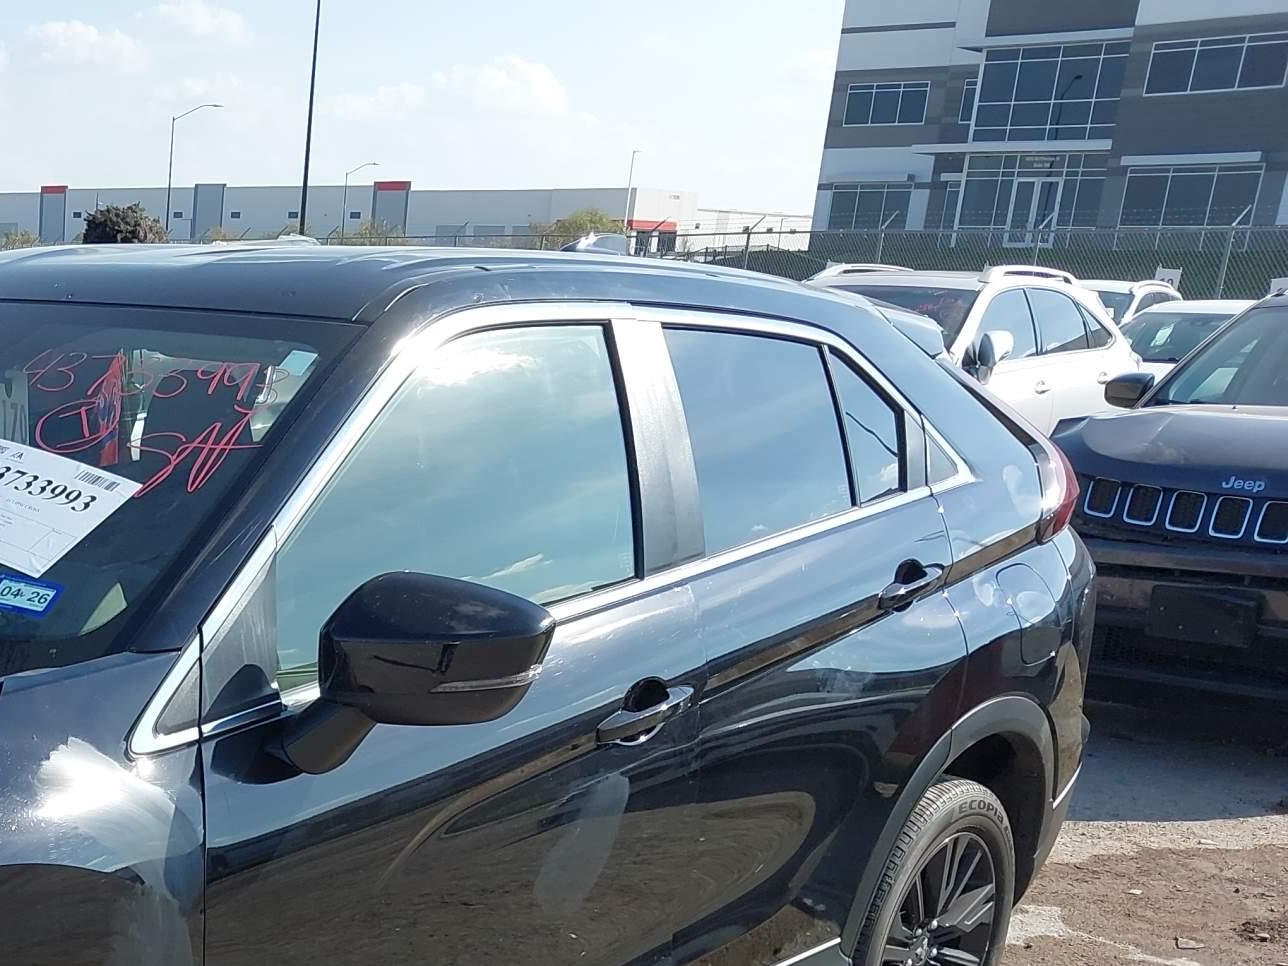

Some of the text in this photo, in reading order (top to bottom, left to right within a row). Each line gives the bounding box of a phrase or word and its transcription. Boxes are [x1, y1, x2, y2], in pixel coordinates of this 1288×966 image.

[1222, 475, 1265, 493] Jeep
[0, 585, 51, 605] 04 26
[958, 799, 1004, 825] ECOPIA
